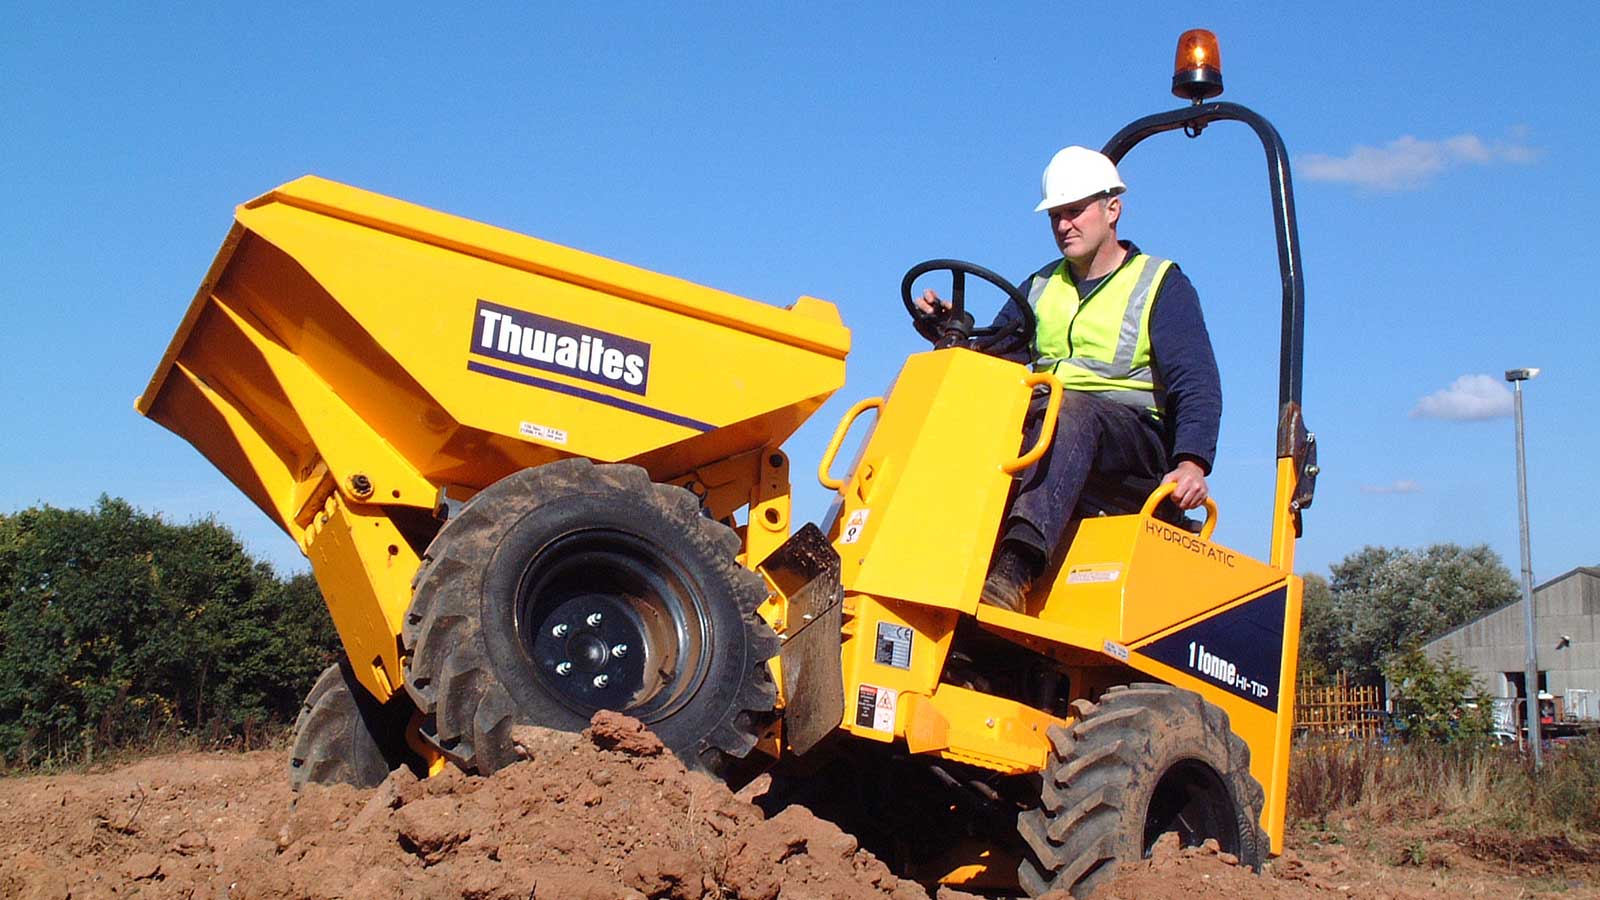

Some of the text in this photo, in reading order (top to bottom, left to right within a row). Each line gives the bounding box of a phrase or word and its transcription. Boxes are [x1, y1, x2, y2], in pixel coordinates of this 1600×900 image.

[480, 309, 644, 386] Thwaites
[1146, 520, 1235, 568] HYDROSTATIC
[1189, 641, 1269, 698] 1 tonne HI-TIP
